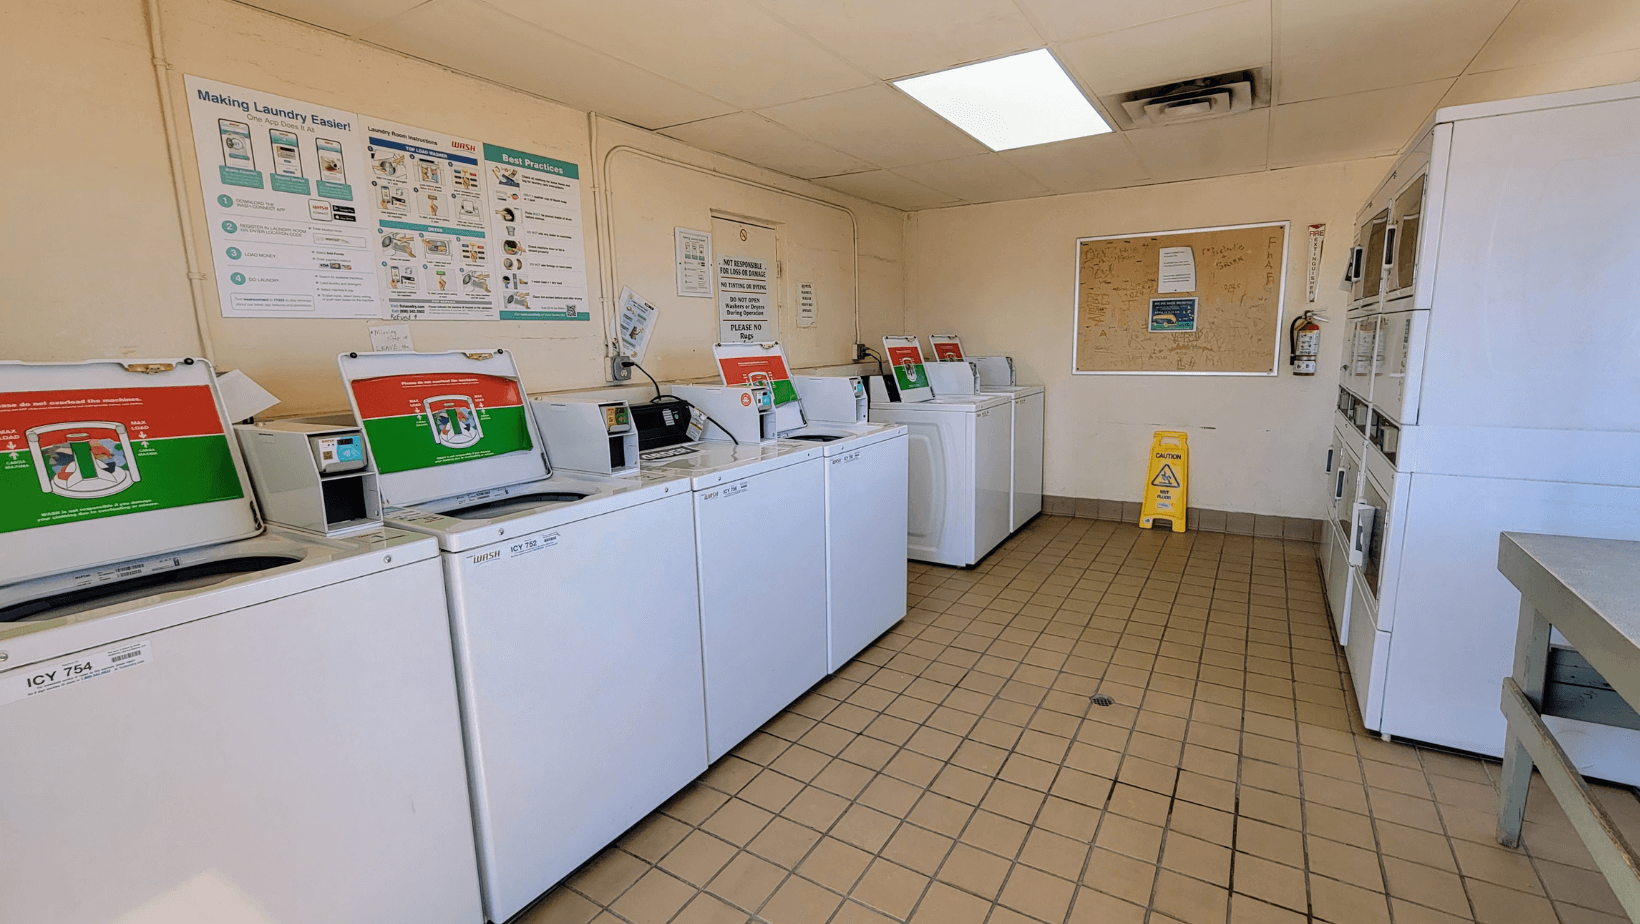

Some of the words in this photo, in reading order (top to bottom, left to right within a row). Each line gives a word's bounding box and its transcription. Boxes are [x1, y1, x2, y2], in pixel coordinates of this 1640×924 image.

[198, 89, 250, 112] Making
[254, 102, 307, 124] Laundry
[311, 114, 351, 131] Easier!
[247, 114, 263, 122] One
[265, 117, 279, 126] App
[281, 120, 299, 130] Does
[368, 126, 390, 136] Laundry
[408, 135, 437, 145] Instructions
[452, 141, 476, 151] WASH
[502, 154, 523, 166] Best
[524, 159, 564, 174] Practices
[734, 260, 762, 269] RESPONSIBLE
[1309, 237, 1318, 294] EXTINGUISHER
[511, 543, 523, 552] ICY
[525, 540, 537, 548] 752
[473, 550, 501, 564] WASH
[26, 670, 57, 688] ICY
[63, 661, 93, 677] 754
